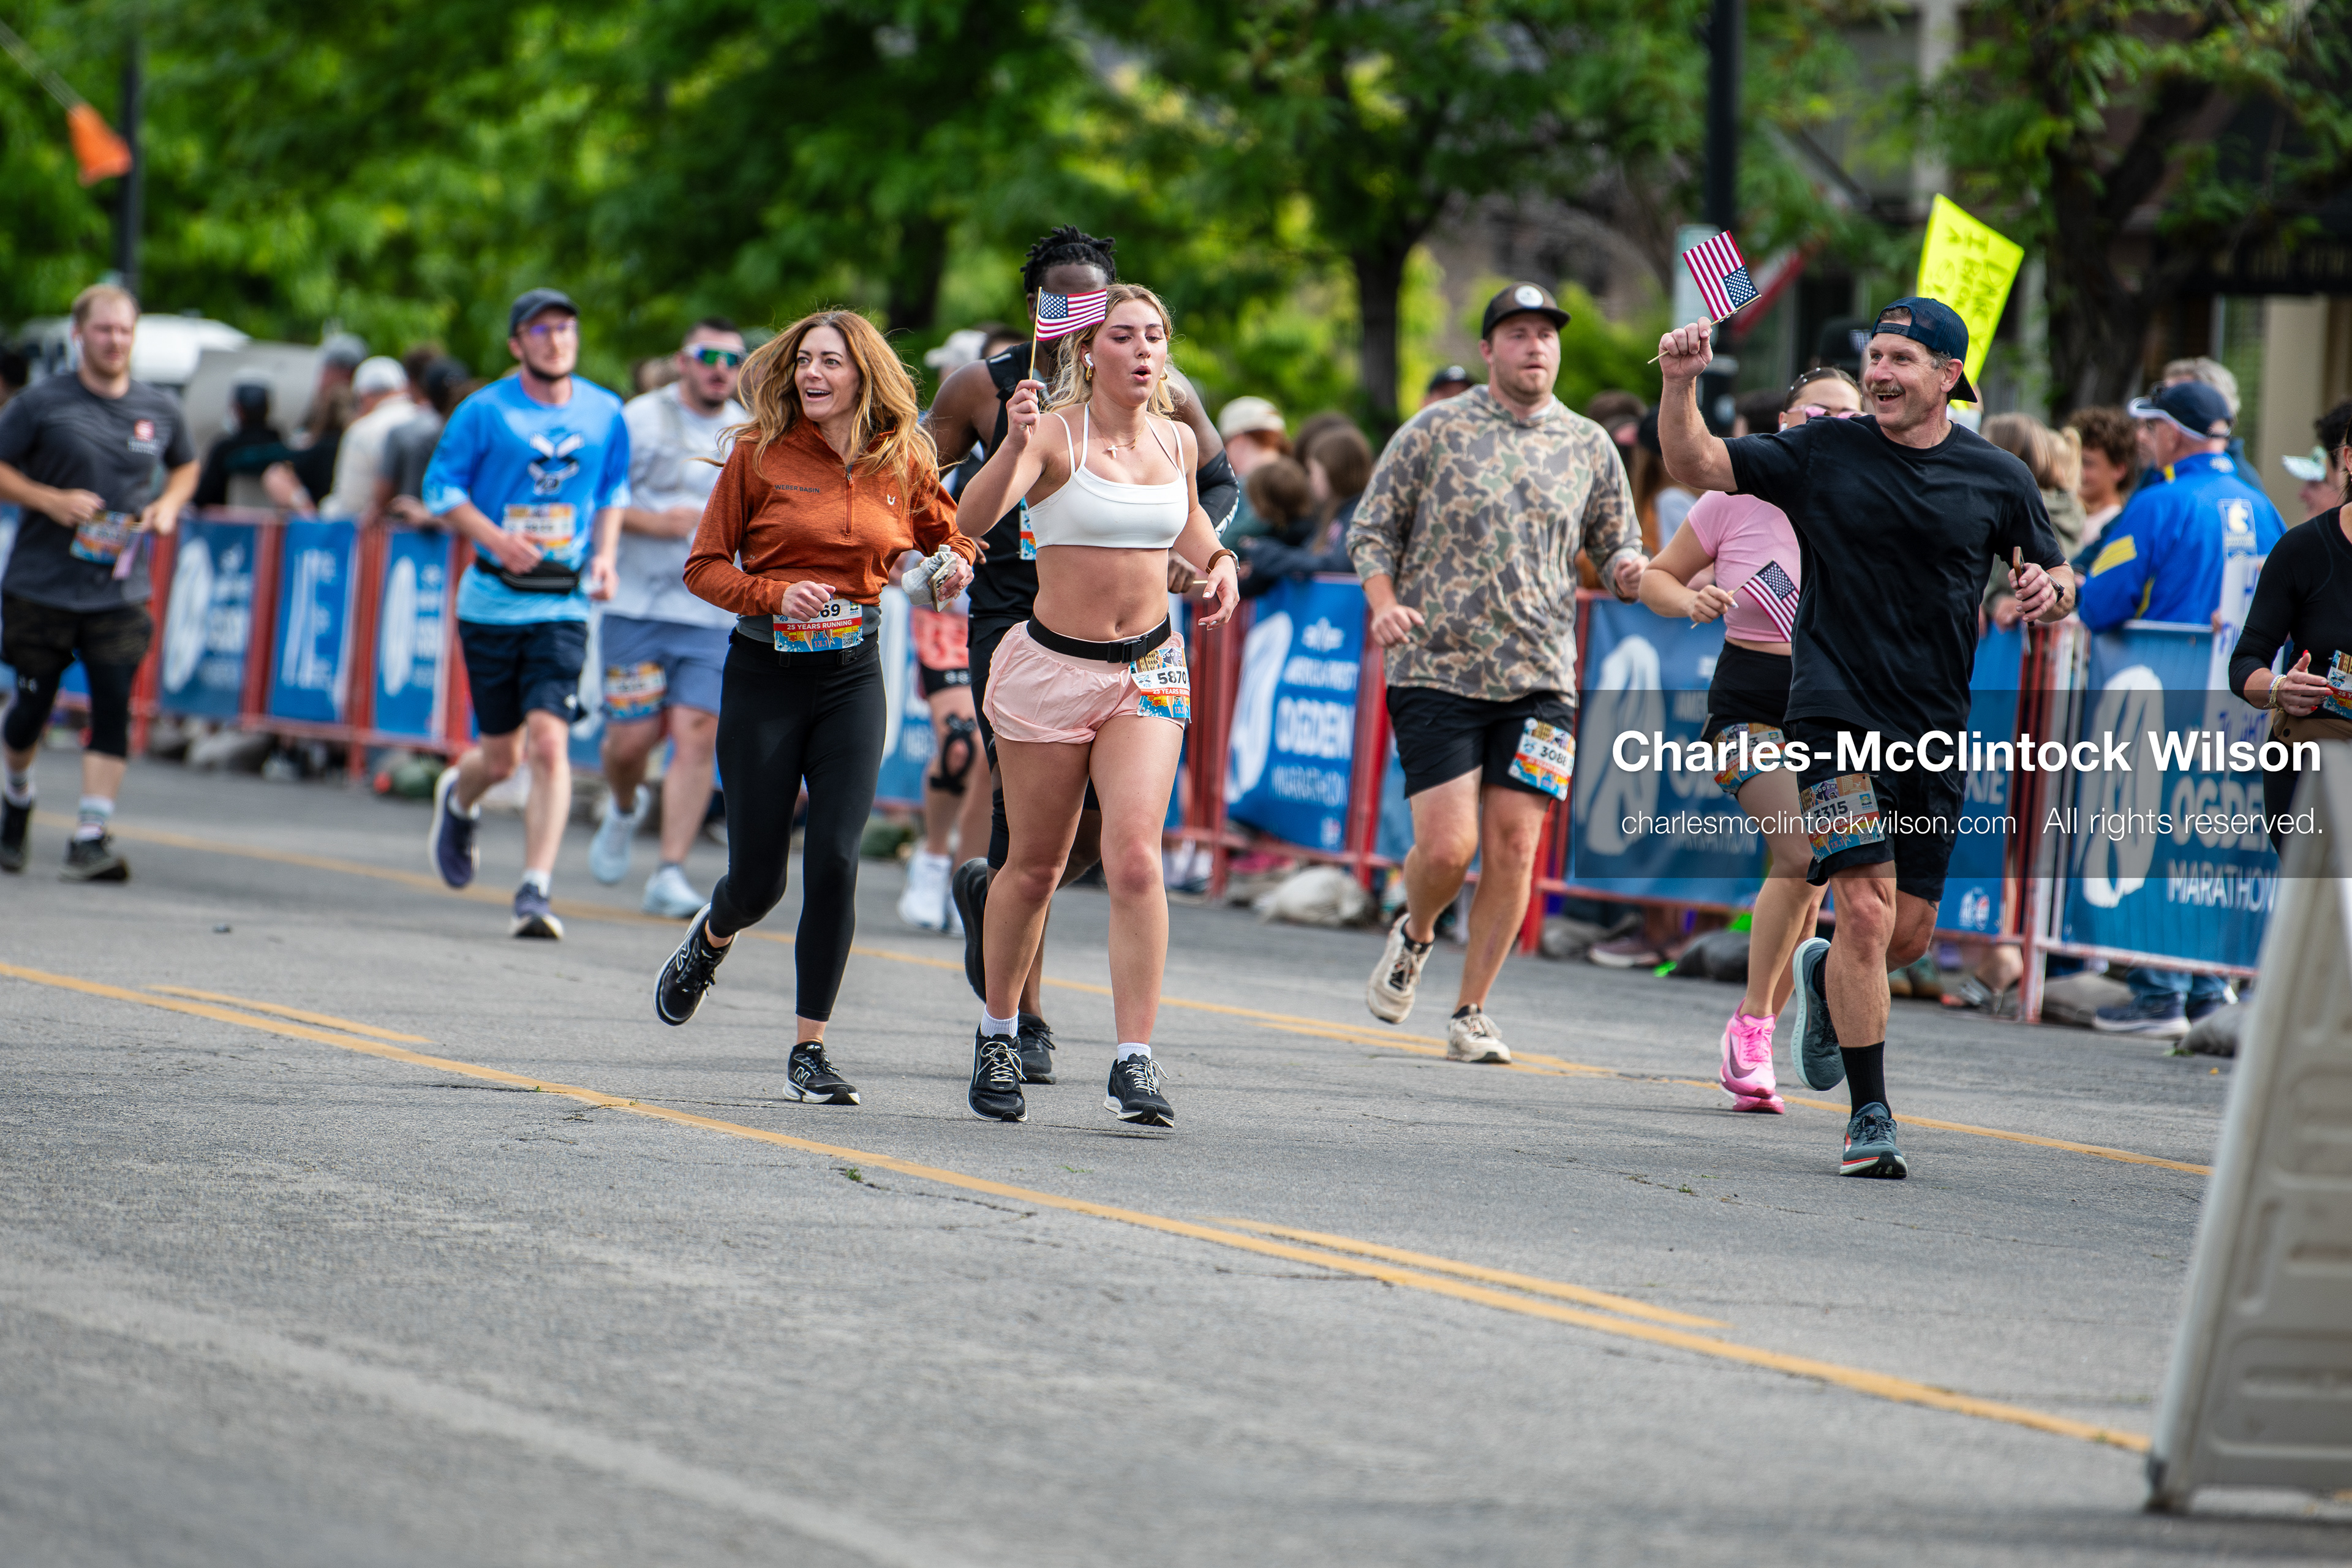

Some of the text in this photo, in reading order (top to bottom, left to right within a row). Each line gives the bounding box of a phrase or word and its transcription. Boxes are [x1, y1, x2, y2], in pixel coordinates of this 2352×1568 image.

[816, 603, 841, 619] 69
[822, 619, 853, 628] RUNNING
[1157, 671, 1187, 685] 5870
[1814, 784, 1836, 795] OGDEN
[1814, 801, 1849, 823] 3315
[1830, 840, 1844, 849] 13.1
